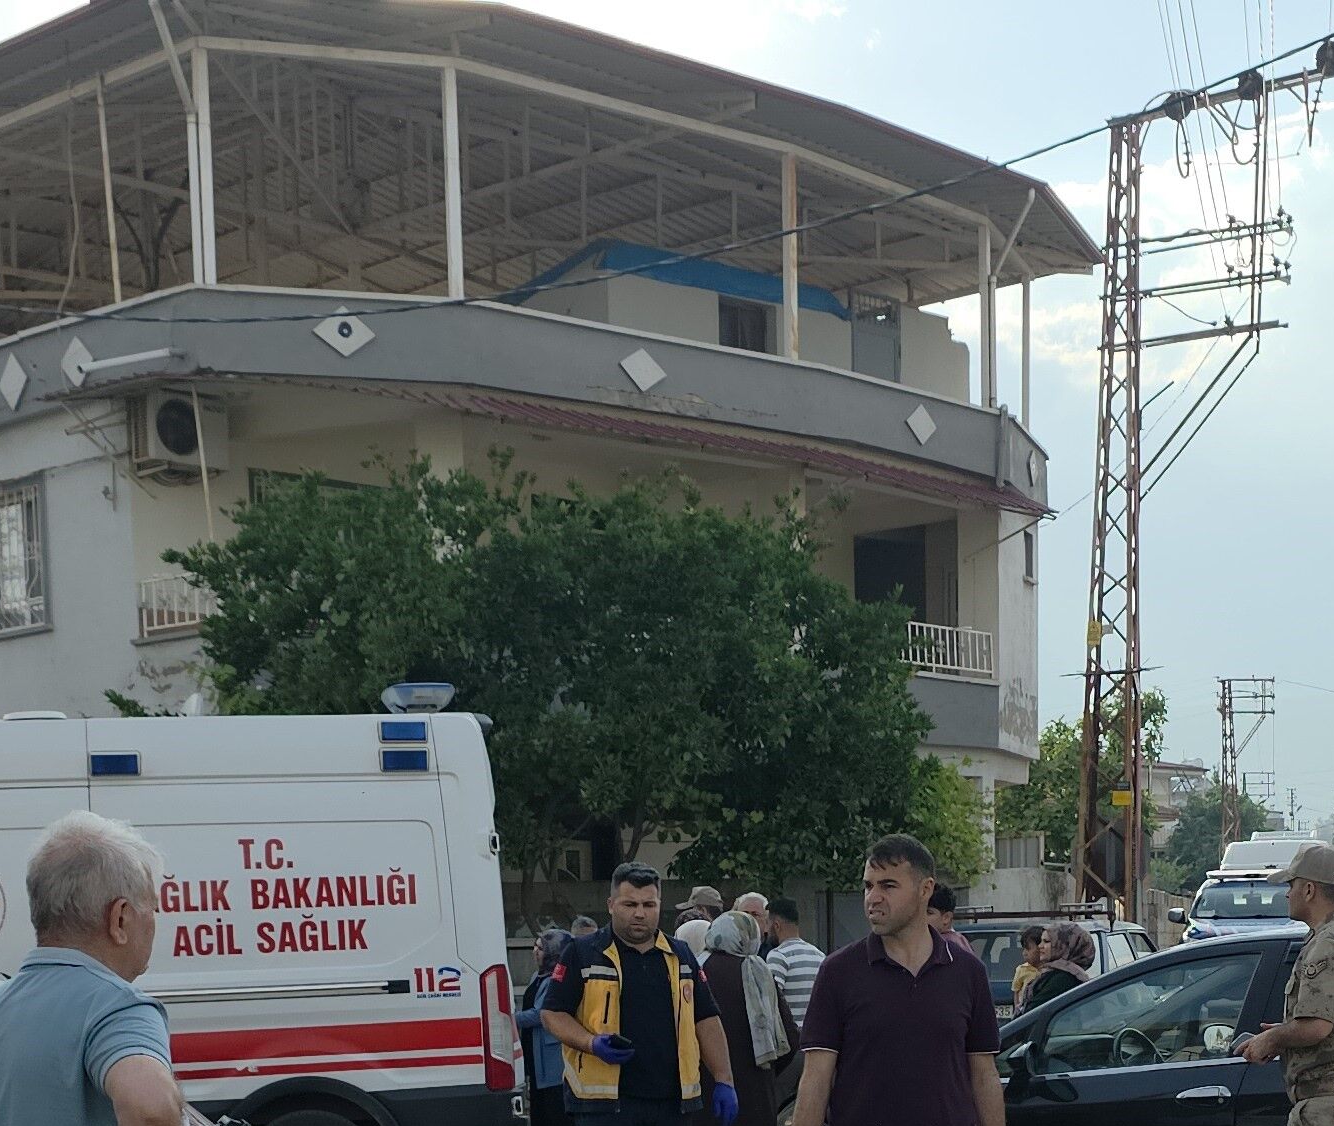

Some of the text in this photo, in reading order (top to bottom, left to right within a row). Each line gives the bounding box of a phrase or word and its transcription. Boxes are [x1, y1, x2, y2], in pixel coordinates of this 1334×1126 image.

[238, 838, 294, 870] T.C.
[155, 866, 417, 914] ĞLIK BAKANLIĞI
[173, 913, 368, 957] ACİL SAĞLIK
[413, 967, 461, 993] 112
